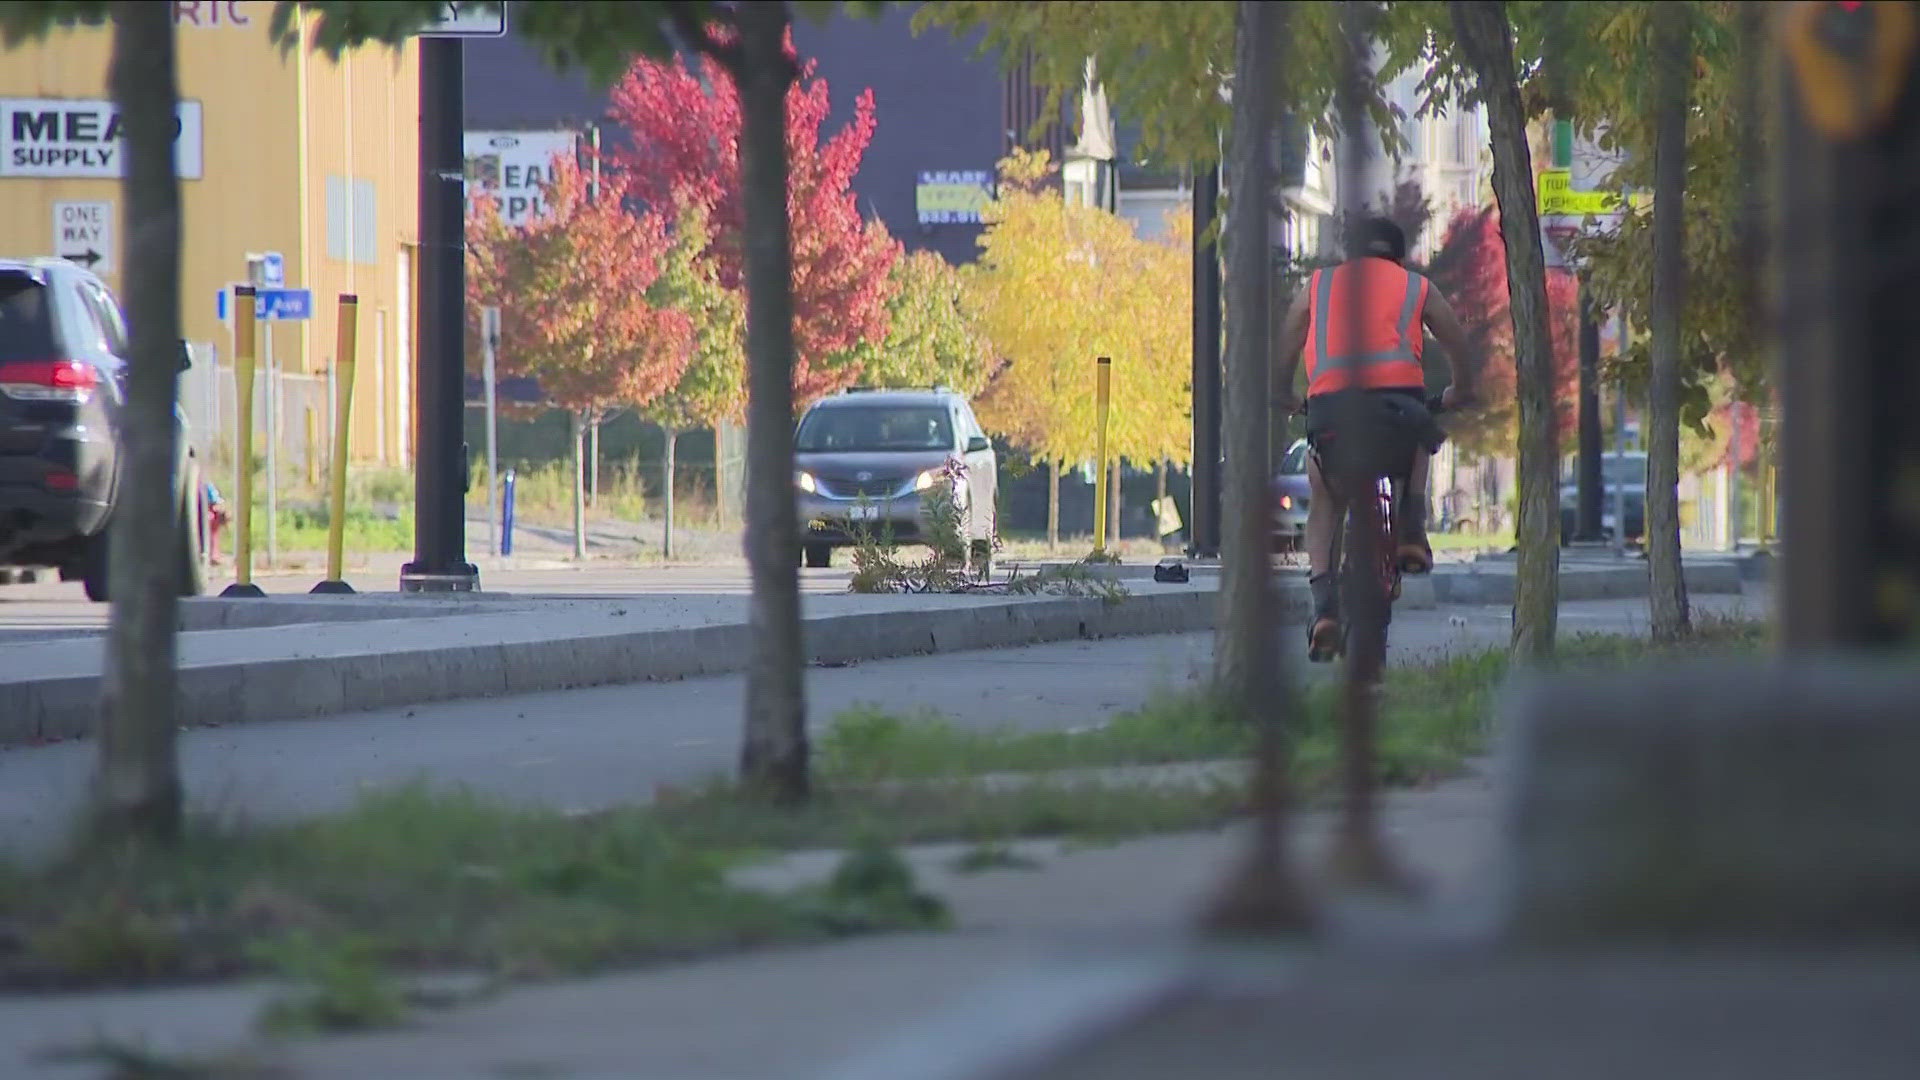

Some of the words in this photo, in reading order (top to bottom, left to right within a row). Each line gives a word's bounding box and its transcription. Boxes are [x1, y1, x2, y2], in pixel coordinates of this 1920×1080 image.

[13, 148, 113, 166] SUPPLY
[63, 206, 101, 223] ONE
[63, 227, 101, 241] WAY
